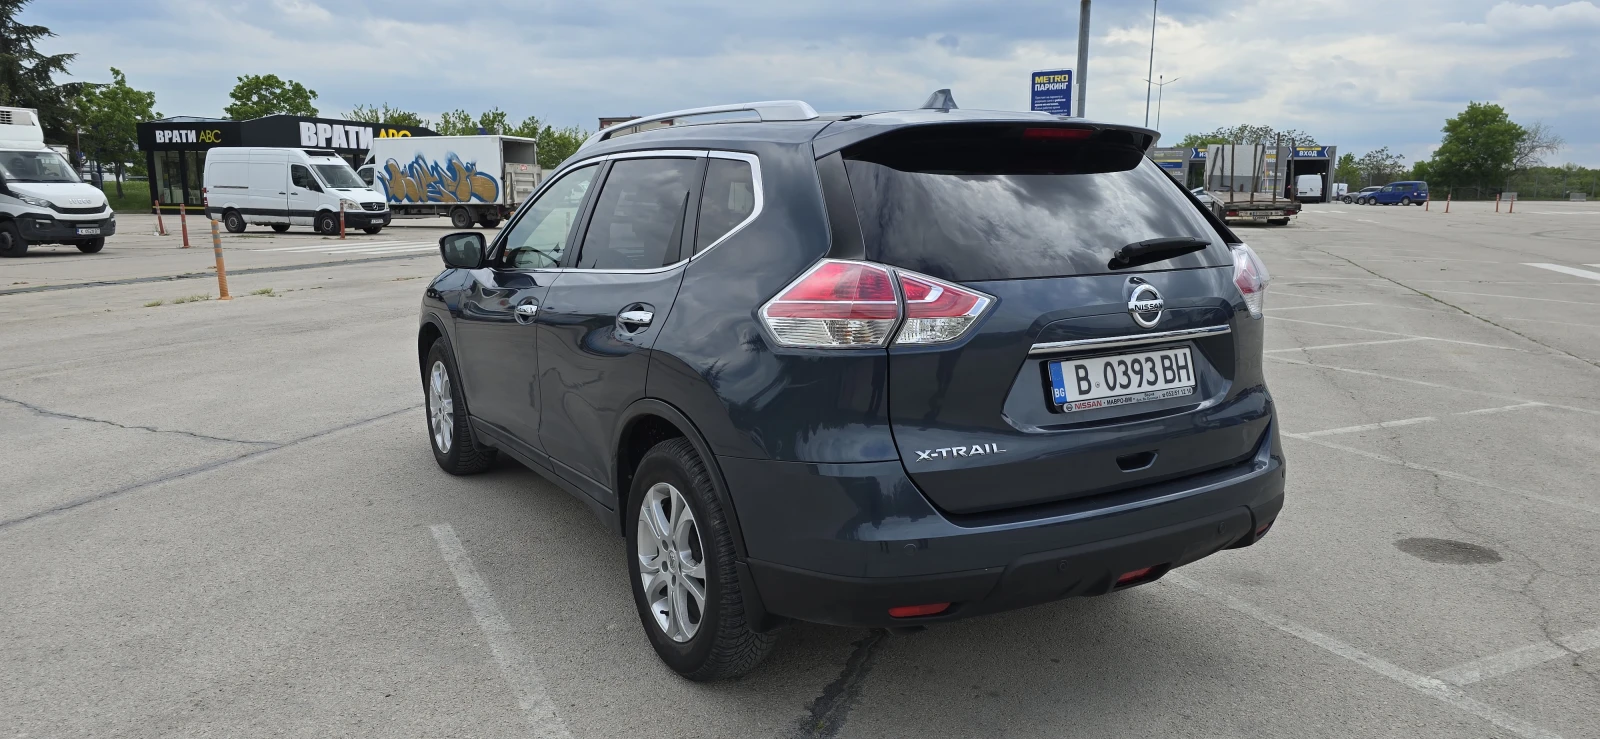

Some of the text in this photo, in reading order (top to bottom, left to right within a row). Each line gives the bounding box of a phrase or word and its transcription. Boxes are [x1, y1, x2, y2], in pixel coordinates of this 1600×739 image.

[1035, 75, 1068, 83] METRO
[1035, 82, 1068, 91] ПАРКИНГ
[155, 129, 221, 143] ВРАТИ ABC
[299, 121, 374, 149] ВРАТИ
[1135, 303, 1162, 311] NISSAN
[1054, 387, 1065, 398] BG
[1074, 400, 1102, 410] NISSAN
[914, 443, 1007, 462] X-TRAIL
